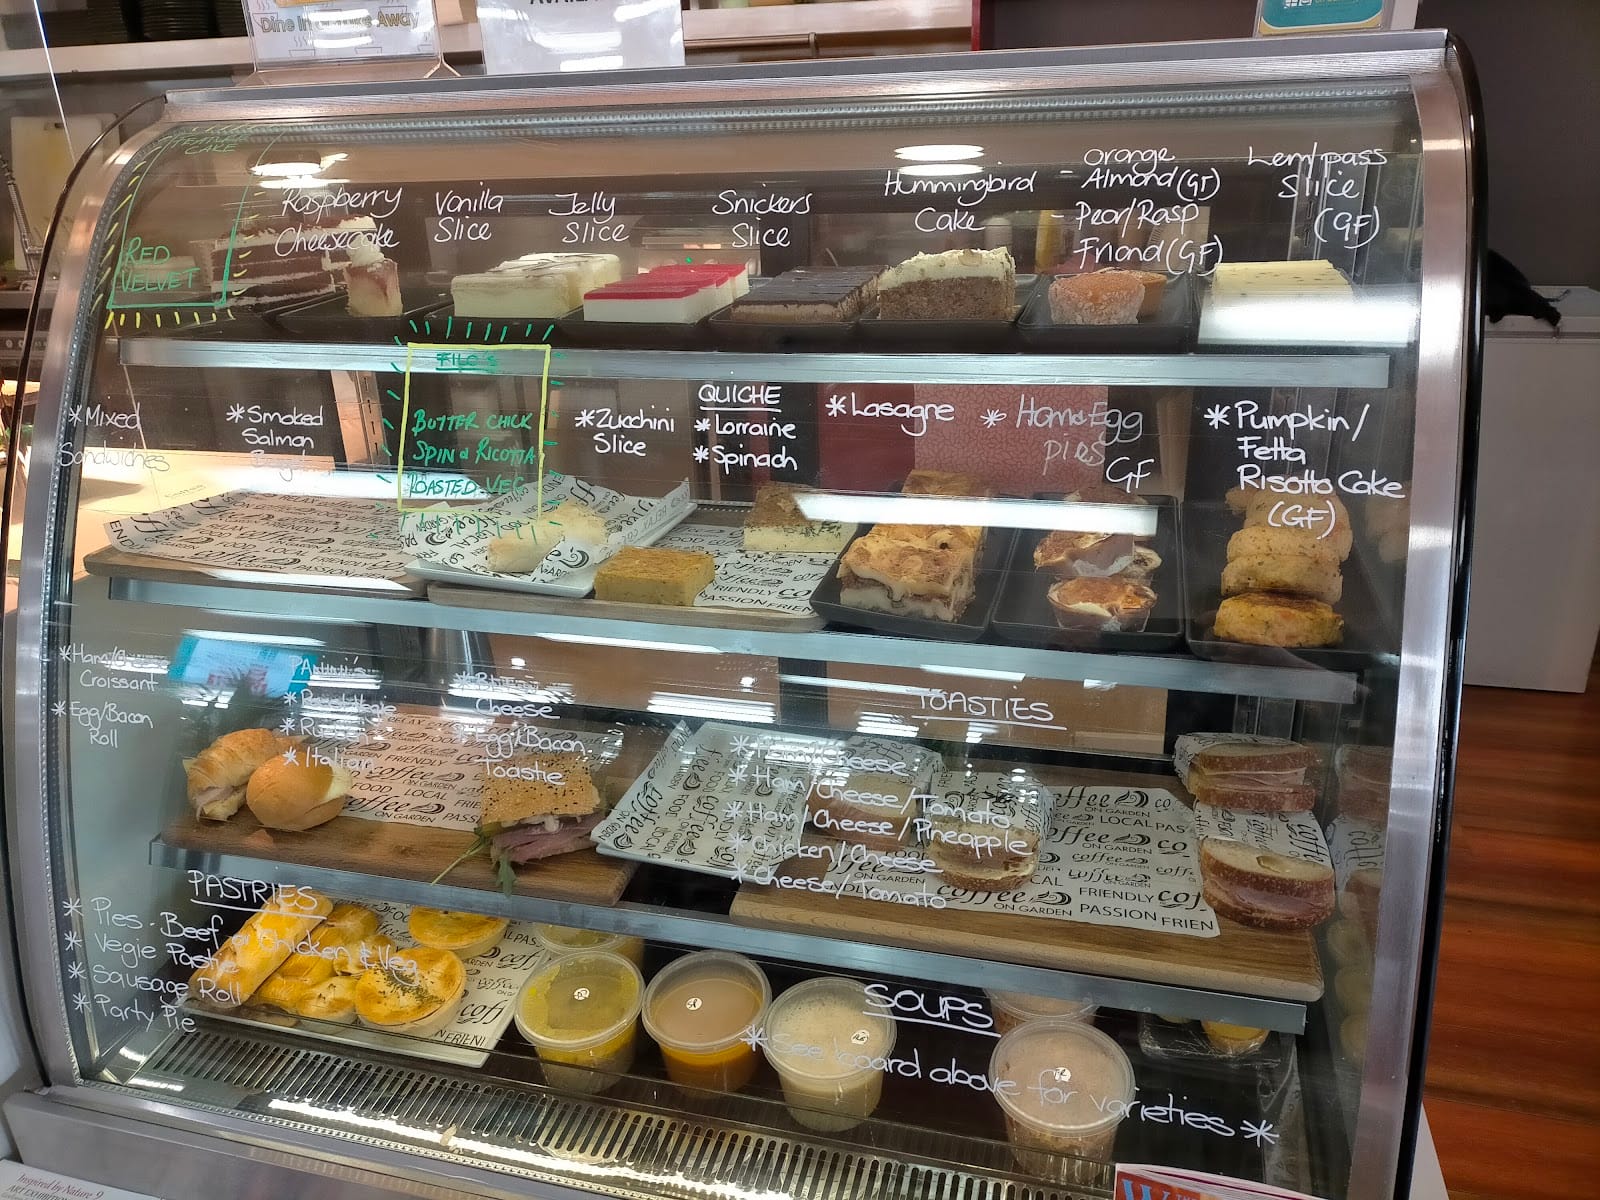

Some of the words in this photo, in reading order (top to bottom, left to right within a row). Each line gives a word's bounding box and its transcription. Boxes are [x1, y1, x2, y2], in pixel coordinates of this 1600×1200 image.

[260, 16, 295, 33] Dine
[377, 10, 419, 28] Away
[884, 167, 1038, 206] Hummingbird
[1278, 168, 1361, 199] Slice
[281, 186, 403, 224] Raspberry
[435, 182, 504, 216] Vanilla
[548, 191, 617, 224] Jelly
[711, 184, 812, 216] Snickers
[433, 217, 493, 243] Slice
[562, 220, 631, 245] Slice
[731, 217, 791, 248] Slice
[914, 207, 985, 234] Cake
[1313, 206, 1381, 249] (GF)
[125, 237, 171, 265] RED
[274, 224, 401, 258] Cheesecake
[121, 267, 201, 293] VELVET
[697, 383, 782, 406] QUICHE
[85, 402, 142, 431] Mixed
[247, 405, 325, 427] Smoked
[411, 409, 479, 436] BUTTER
[486, 412, 533, 431] CHICK
[595, 404, 676, 433] Zucchini
[714, 414, 798, 440] Lorraine
[851, 396, 955, 437] Lasagne
[241, 428, 315, 449] Salmon
[412, 440, 457, 466] SPIN
[475, 437, 536, 466] RICOTTA
[592, 432, 647, 457] Slice
[1237, 437, 1307, 464] Fetta
[59, 440, 171, 472] Sandwiches
[713, 445, 798, 475] Spinach
[486, 474, 527, 494] VEG
[1106, 456, 1155, 494] GF
[1239, 463, 1333, 494] Risotto
[1336, 468, 1406, 499] Cake
[1267, 499, 1337, 540] (GF)
[79, 669, 159, 692] Croissant
[70, 701, 154, 731] Egg/Bacon
[475, 698, 561, 720] Cheese
[917, 690, 1054, 722] TOASTIES
[90, 728, 118, 748] Roll
[475, 724, 587, 759] Egg/Bacon
[385, 753, 450, 768] FRIENDLY
[475, 758, 566, 786] Toastie
[350, 782, 393, 794] FOOD
[404, 788, 449, 801] LOCAL
[391, 813, 437, 824] GARDEN
[1100, 815, 1152, 828] LOCAL
[1105, 808, 1151, 818] GARDEN
[1072, 852, 1123, 864] coffee
[1082, 842, 1101, 850] ON
[1104, 844, 1153, 855] GARDEN
[187, 869, 319, 911] PASTRIES
[853, 871, 875, 880] ON
[876, 873, 927, 885] GARDEN
[993, 901, 1016, 912] ON
[1018, 904, 1073, 917] GARDEN
[1079, 887, 1155, 904] FRIENDLY
[91, 897, 144, 930] Pies
[159, 912, 224, 950] Beef
[1080, 903, 1158, 922] PASSION
[1161, 916, 1214, 932] FRIEN
[94, 931, 157, 968] Vegie
[91, 964, 189, 1008] Sausage
[197, 977, 242, 1005] Roll
[93, 994, 156, 1033] Party
[161, 1003, 198, 1034] Pie
[863, 983, 995, 1030] SOUPS
[833, 1036, 922, 1080] board
[928, 1049, 1022, 1099] above
[1026, 1069, 1079, 1108] for
[1090, 1086, 1236, 1138] varieties
